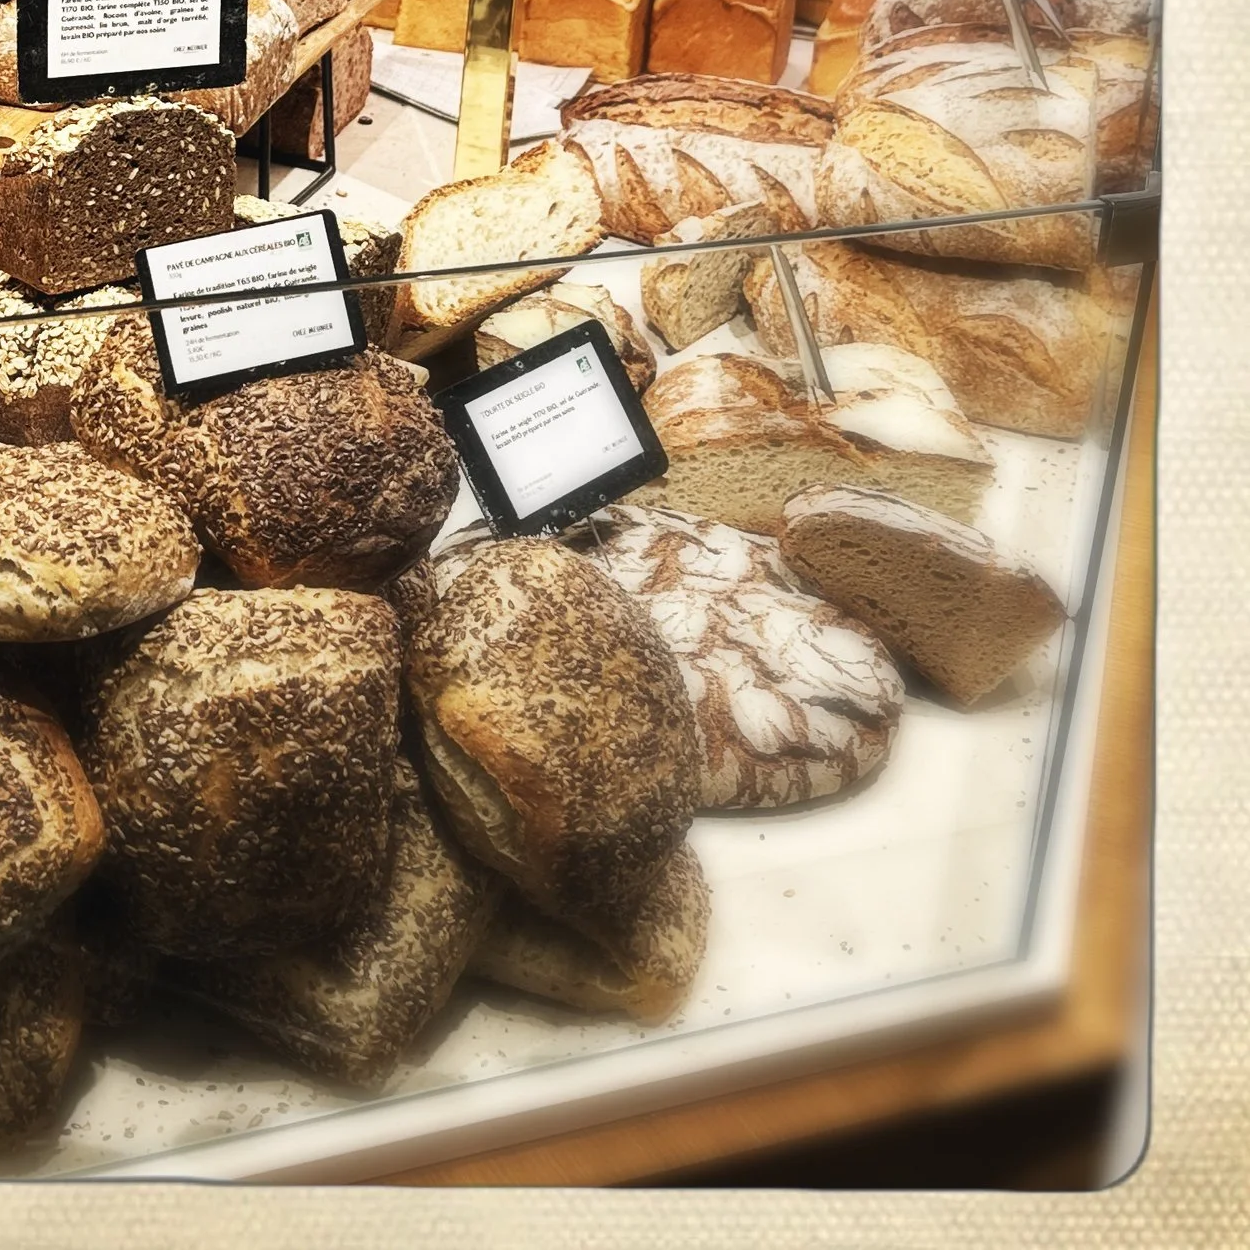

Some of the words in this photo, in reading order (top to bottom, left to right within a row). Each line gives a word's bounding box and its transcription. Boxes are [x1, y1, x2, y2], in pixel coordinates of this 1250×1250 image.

[170, 7, 194, 15] graines
[167, 261, 184, 271] PAVÉ
[185, 260, 194, 268] DE
[195, 252, 232, 265] CAMPAGNE
[235, 249, 248, 257] AUX
[249, 242, 283, 254] CÉRÉALES
[284, 239, 296, 247] BIO
[196, 288, 204, 296] de
[206, 282, 235, 292] tradition
[237, 277, 251, 285] T65
[267, 271, 287, 279] farine
[298, 264, 317, 273] seigle
[208, 306, 233, 318] poolish
[236, 299, 261, 310] naturel
[183, 323, 208, 335] graines
[292, 328, 306, 337] CHEZ
[480, 402, 505, 418] TOURTE
[505, 398, 514, 407] DE
[534, 382, 545, 392] BIO
[511, 432, 522, 442] BIO
